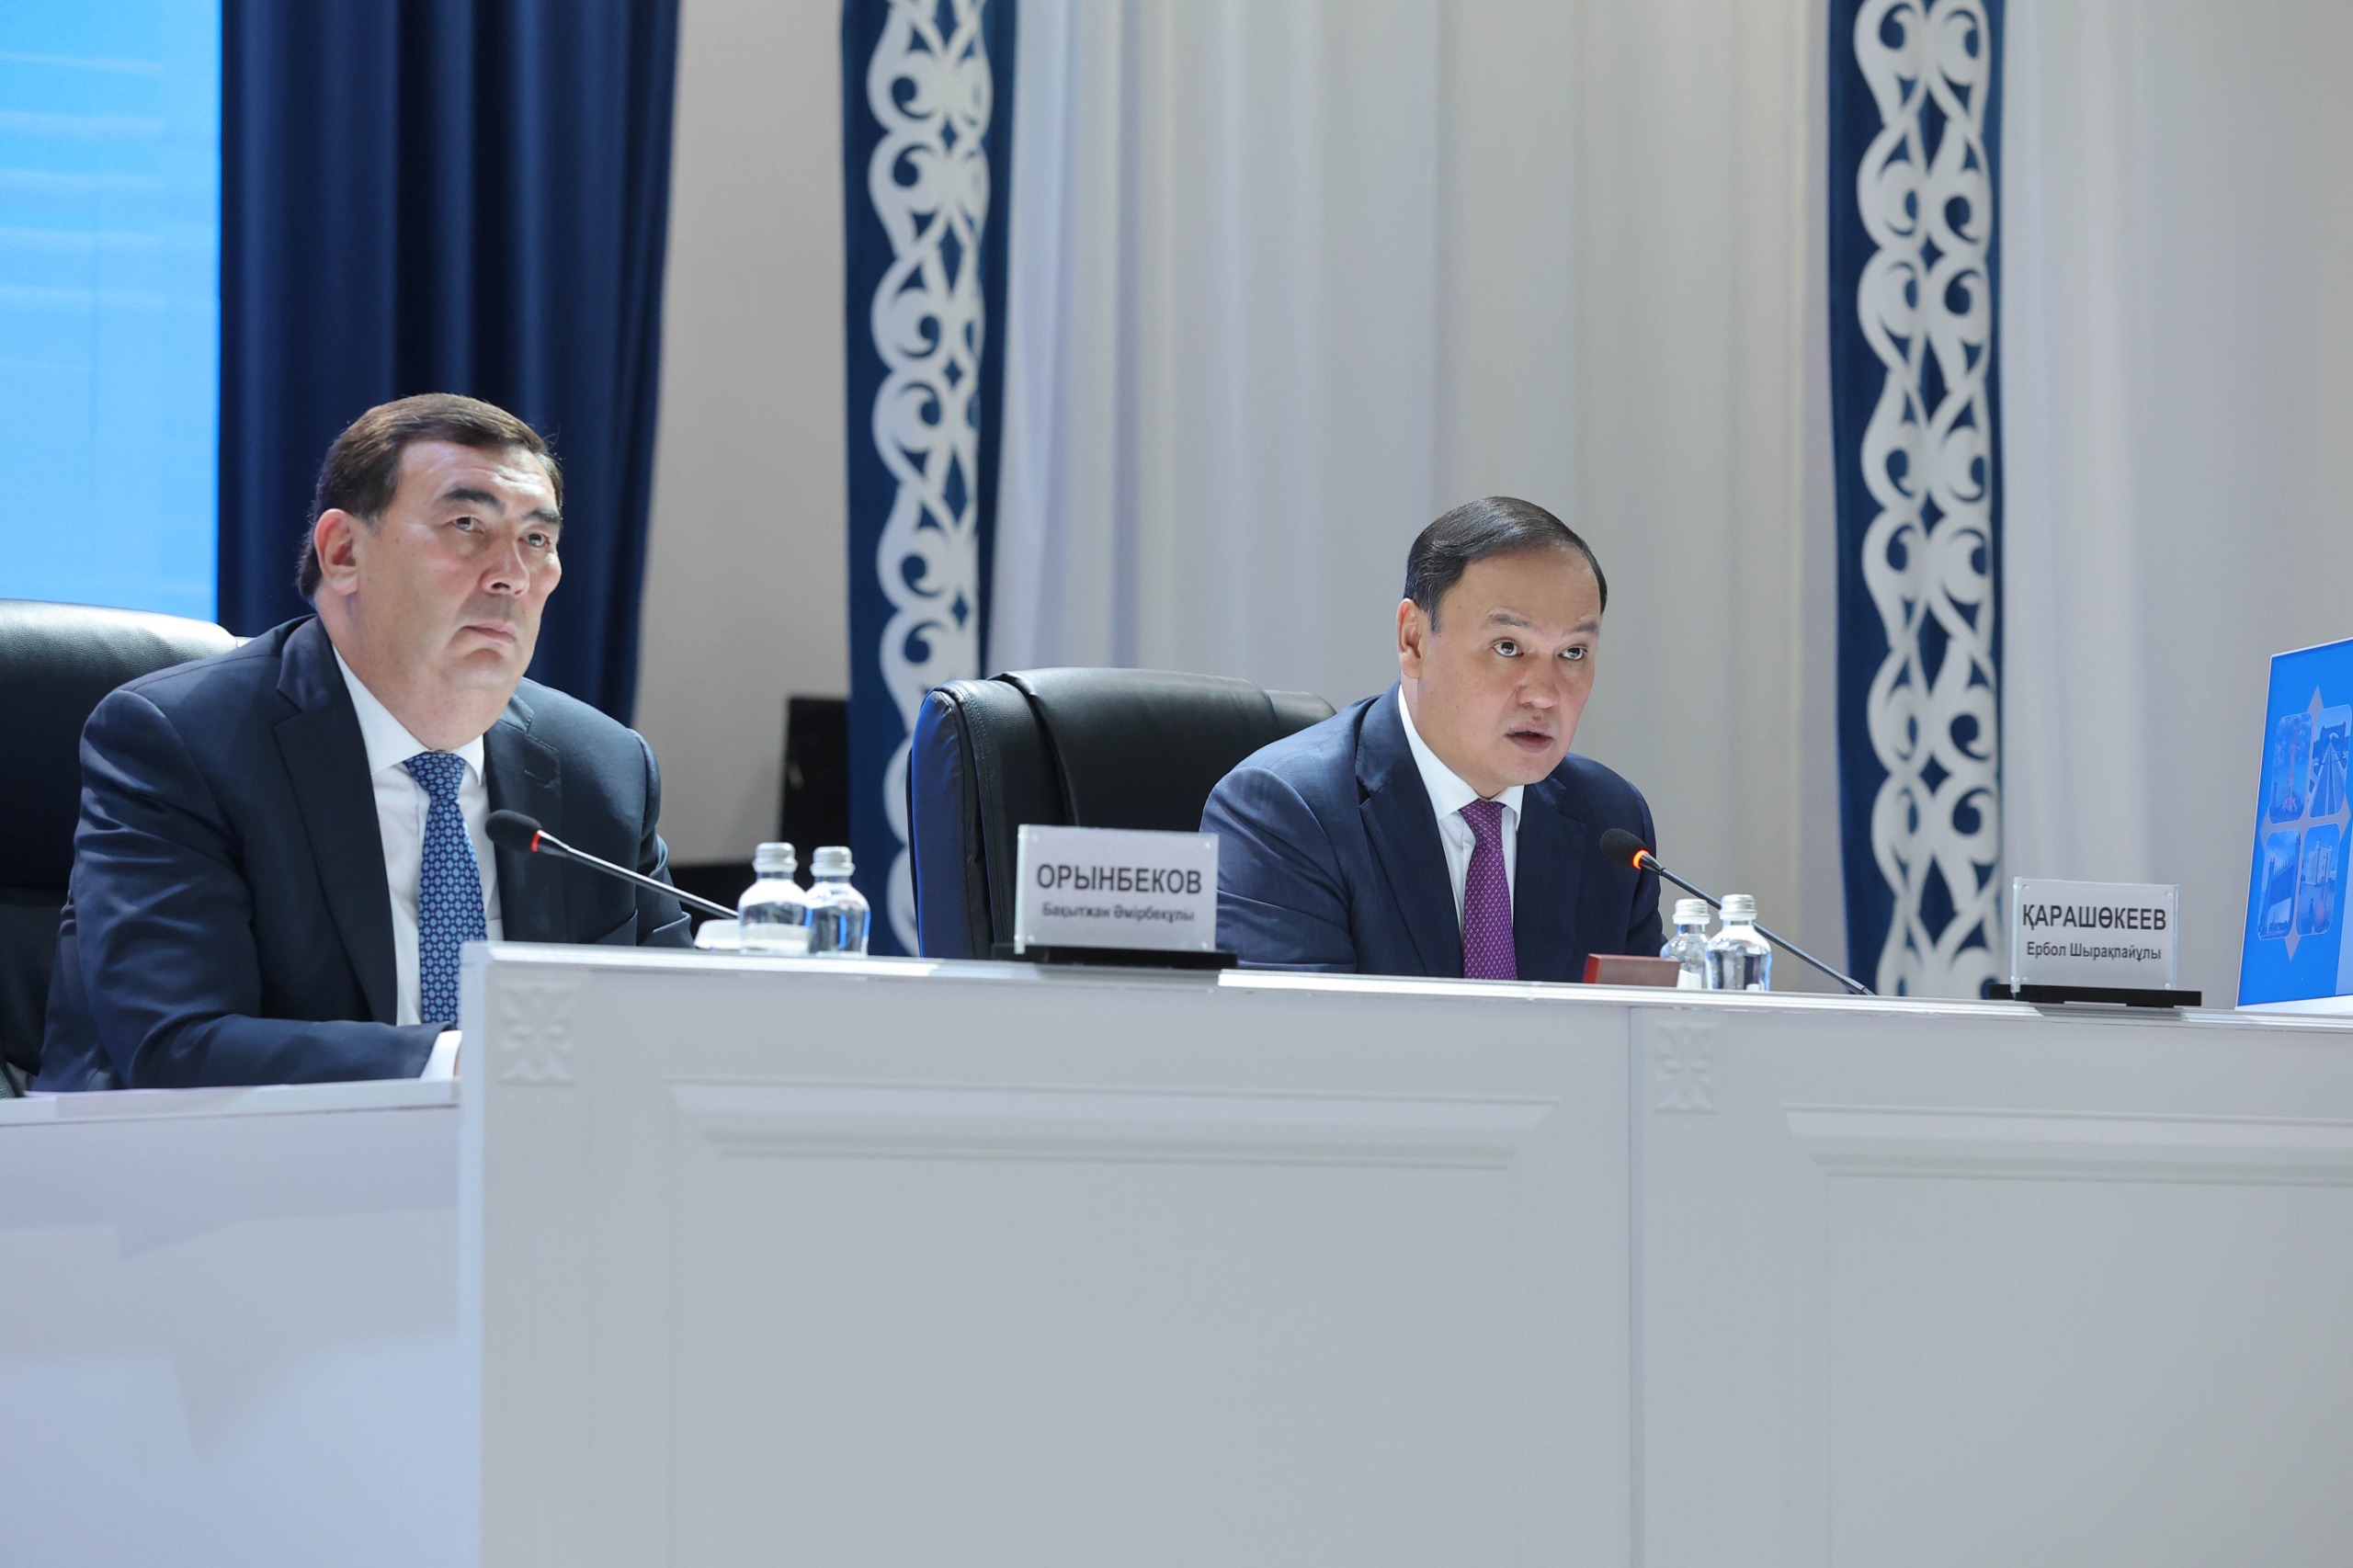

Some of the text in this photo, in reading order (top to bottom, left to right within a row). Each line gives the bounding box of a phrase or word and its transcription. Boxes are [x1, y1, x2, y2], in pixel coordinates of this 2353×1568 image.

[1037, 864, 1202, 894] ОРЫНБЕКОВ
[1042, 903, 1109, 919] Бақытжан
[2023, 903, 2166, 931] ҚАРАШӨКЕЕВ
[2027, 940, 2162, 962] Ербол Шырақпайұлы
